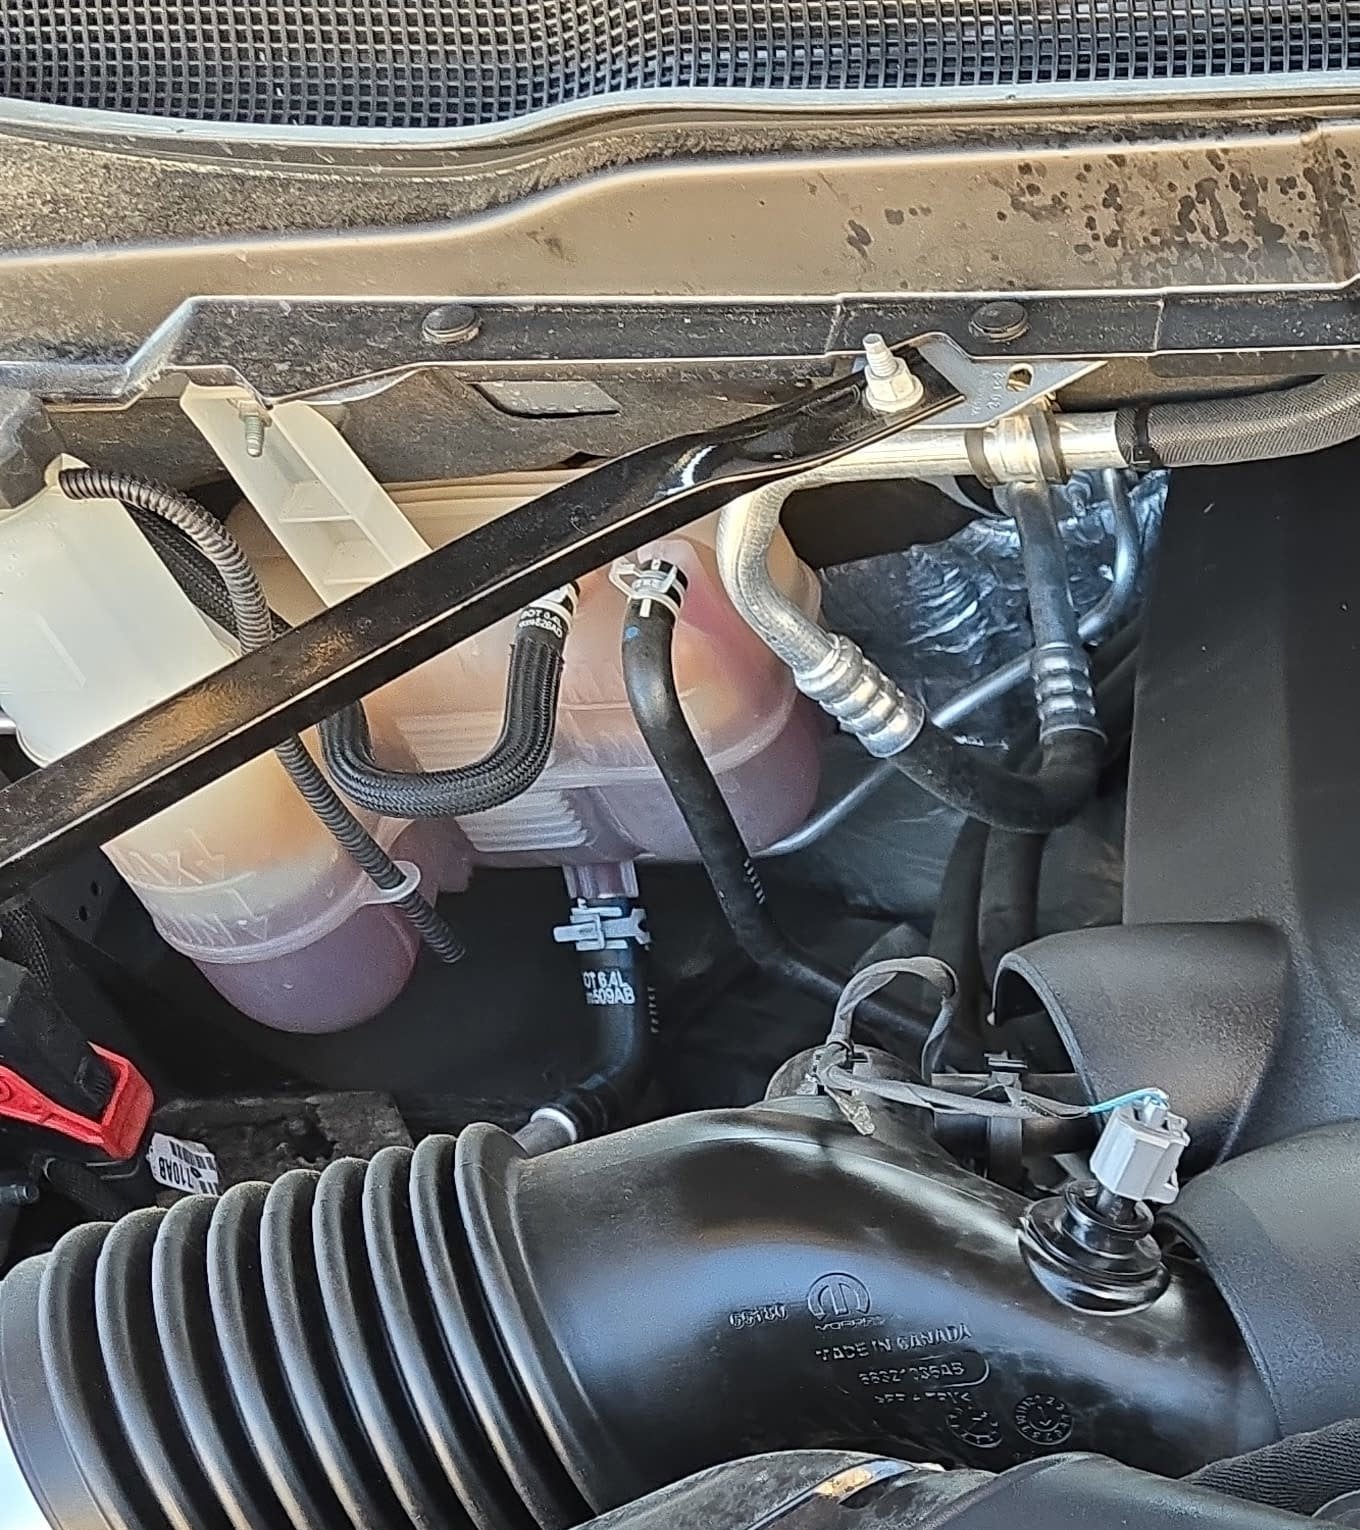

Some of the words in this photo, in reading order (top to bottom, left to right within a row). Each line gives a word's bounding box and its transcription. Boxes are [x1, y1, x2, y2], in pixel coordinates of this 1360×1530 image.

[597, 968, 630, 989] 6.4L
[870, 1337, 892, 1352] IN
[896, 1322, 973, 1351] CANADA
